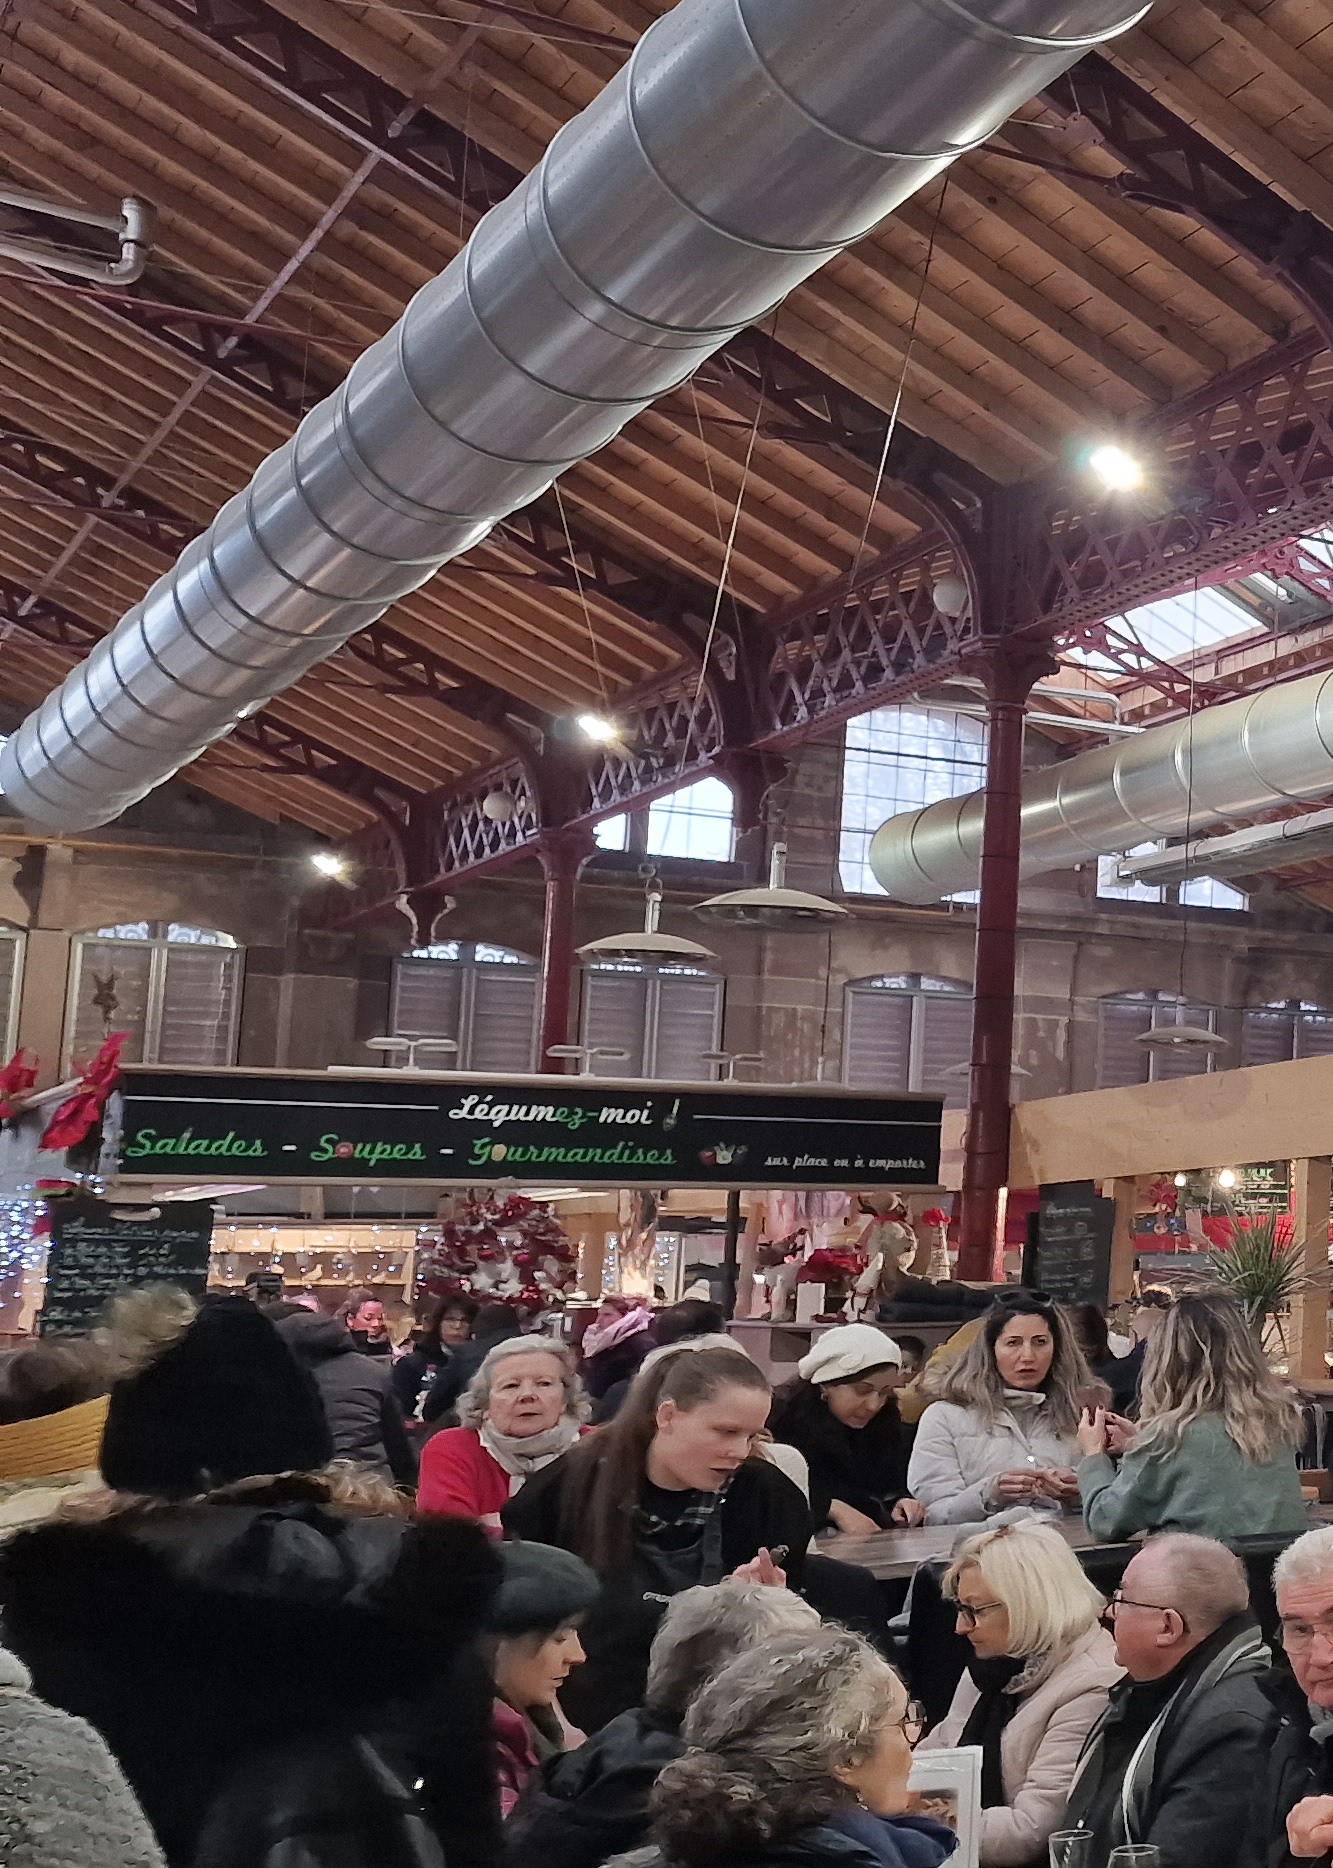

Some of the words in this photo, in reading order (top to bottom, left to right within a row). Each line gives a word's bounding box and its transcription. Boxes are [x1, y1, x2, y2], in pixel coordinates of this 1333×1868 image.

[448, 1094, 653, 1127] Légumez-moi
[126, 1127, 268, 1158] Salades
[310, 1133, 426, 1166] Soupes
[467, 1137, 677, 1168] Gourmandises
[764, 1155, 790, 1166] sur
[793, 1153, 829, 1170] place
[833, 1158, 850, 1168] ou
[868, 1156, 926, 1171] emporter
